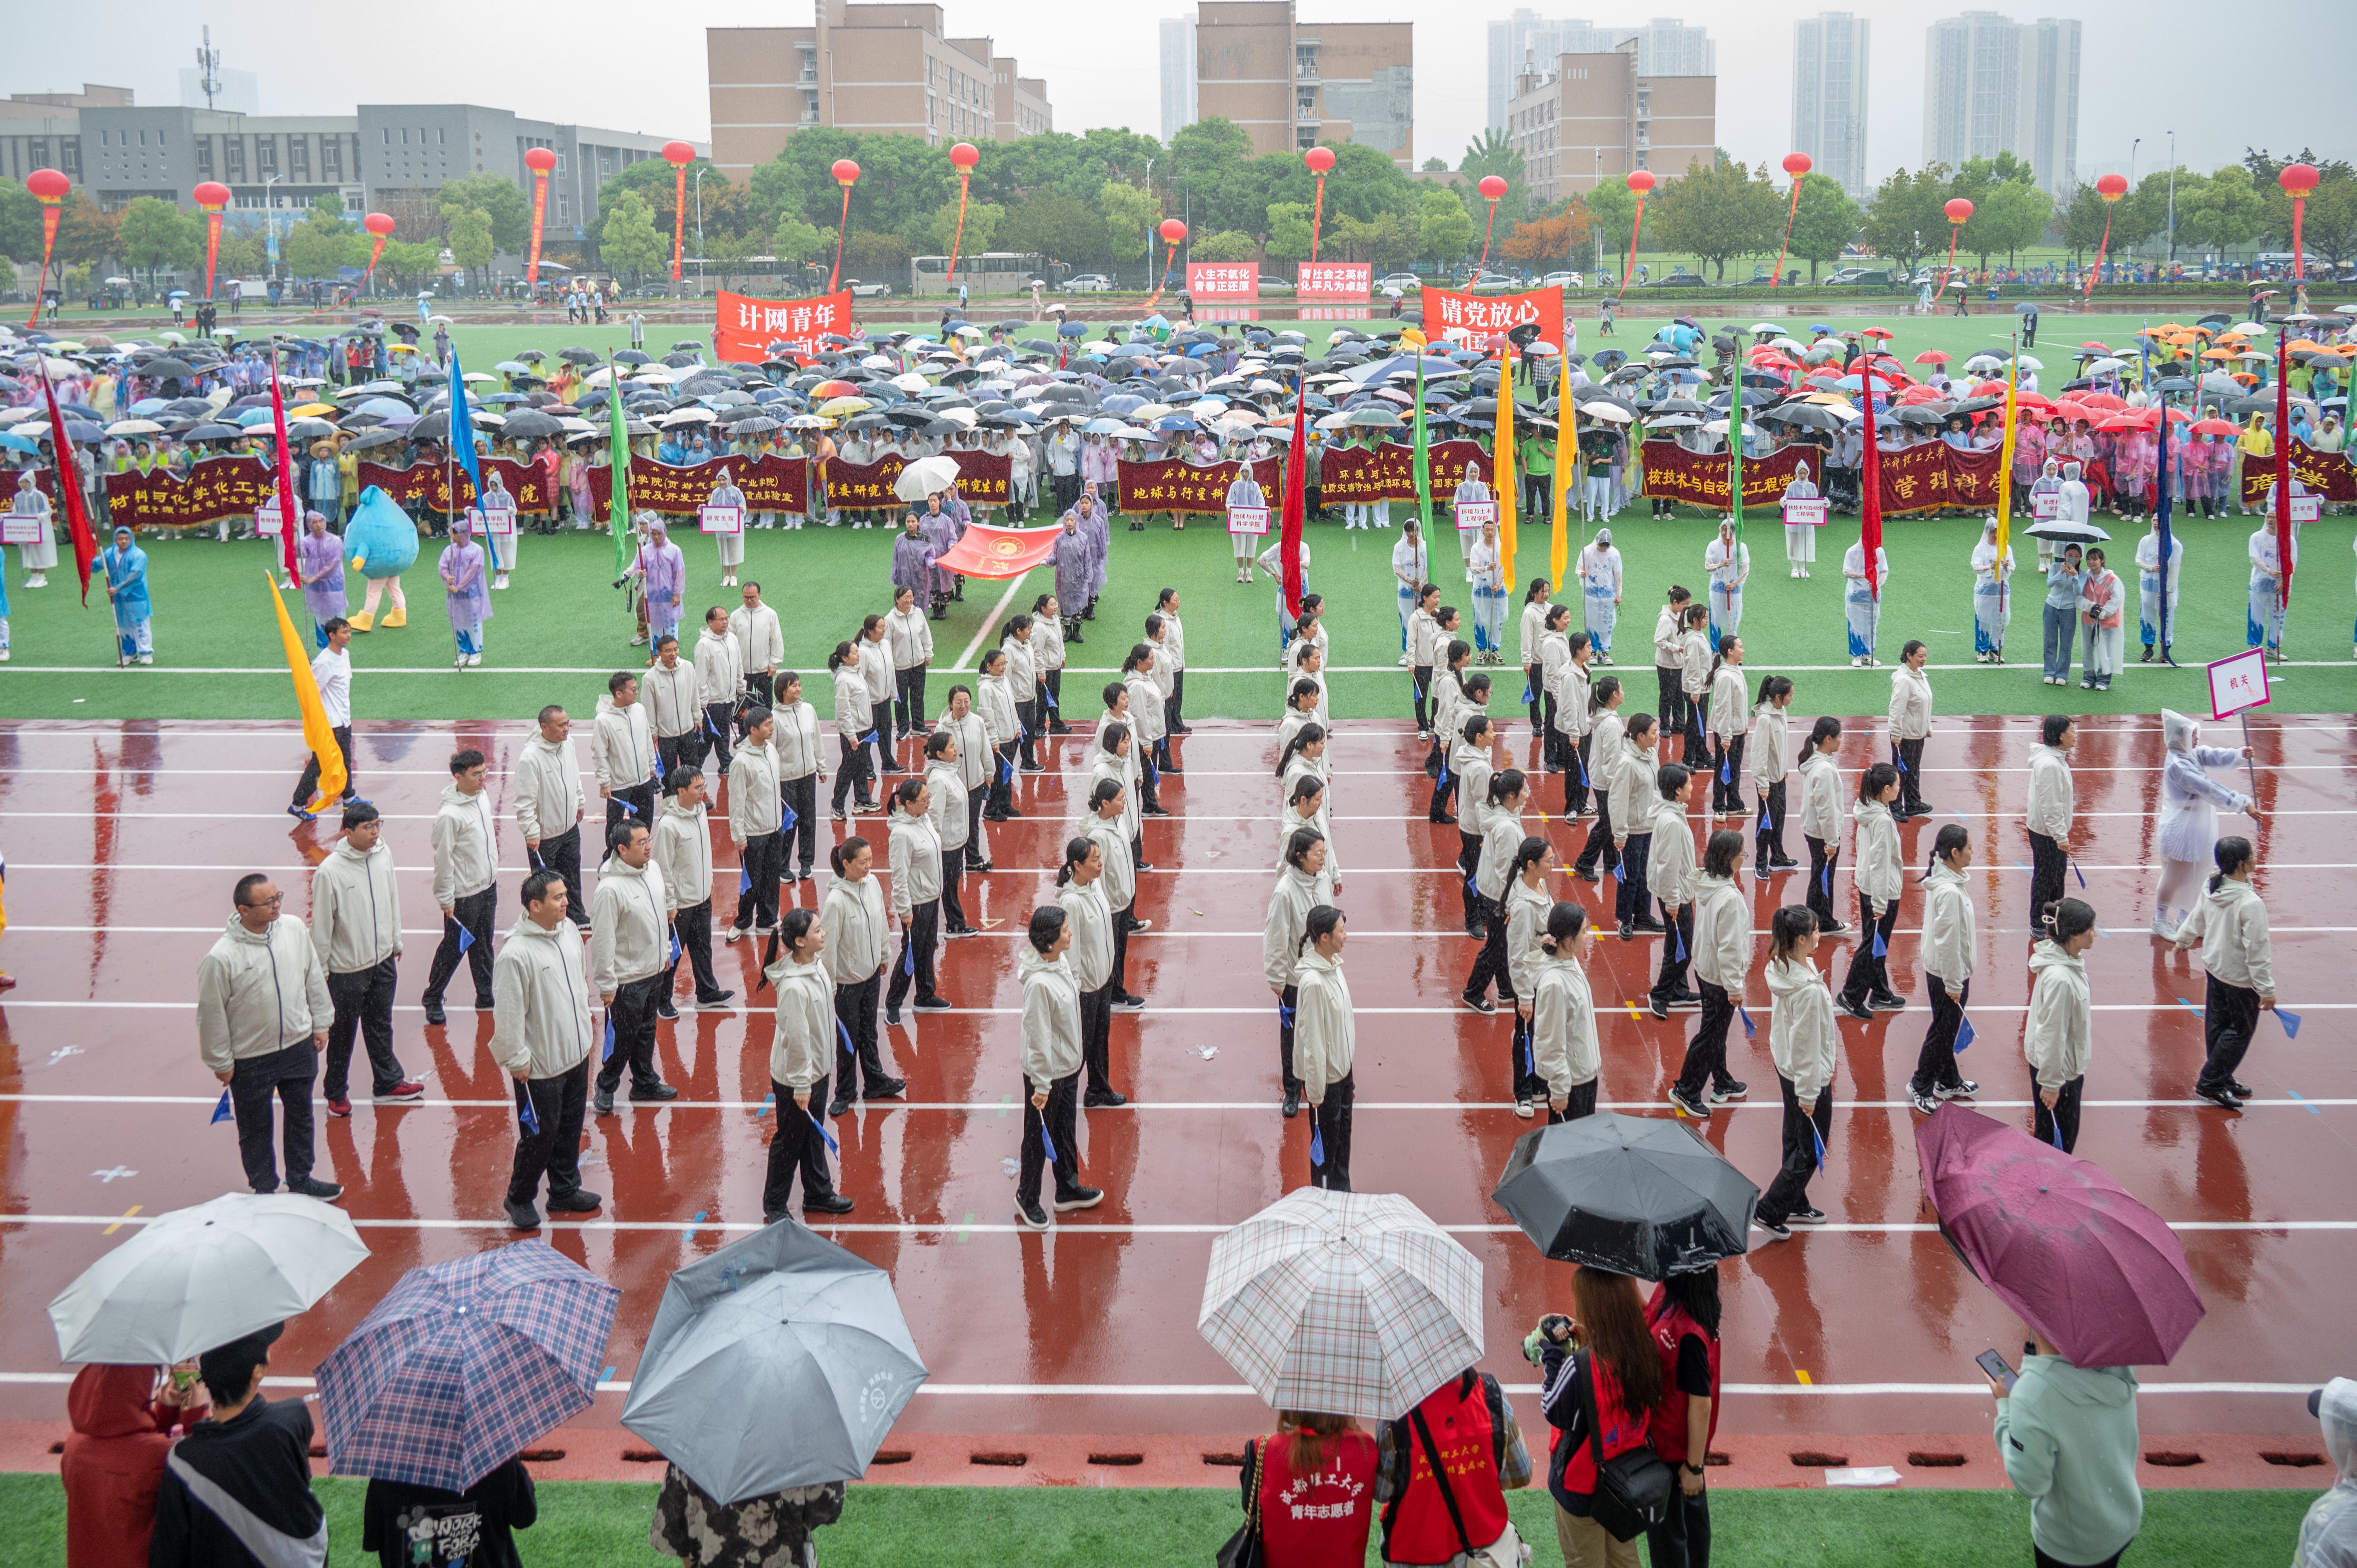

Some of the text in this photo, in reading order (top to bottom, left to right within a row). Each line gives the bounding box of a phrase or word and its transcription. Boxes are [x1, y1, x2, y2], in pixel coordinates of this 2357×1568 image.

[1194, 268, 1250, 280] 人生不氧化
[1301, 269, 1368, 280] 育社会之英材
[1194, 281, 1249, 292] 青春正还原
[1300, 280, 1368, 292] 化平凡为卓越
[738, 303, 835, 333] 计网青年
[1440, 297, 1539, 327] 请党放心
[1340, 464, 1480, 480] 环境与土木程学
[1647, 468, 1798, 497] 核技术与自动工程学
[110, 481, 276, 510] 材料与化学化工学
[383, 482, 539, 504] 球物理院
[1133, 486, 1274, 501] 地球与行星科院
[1233, 513, 1264, 521] 地球与行星
[2230, 674, 2248, 690] 机关
[1419, 1444, 1479, 1464] 成理工大学
[1291, 1499, 1355, 1520] 青年志愿者
